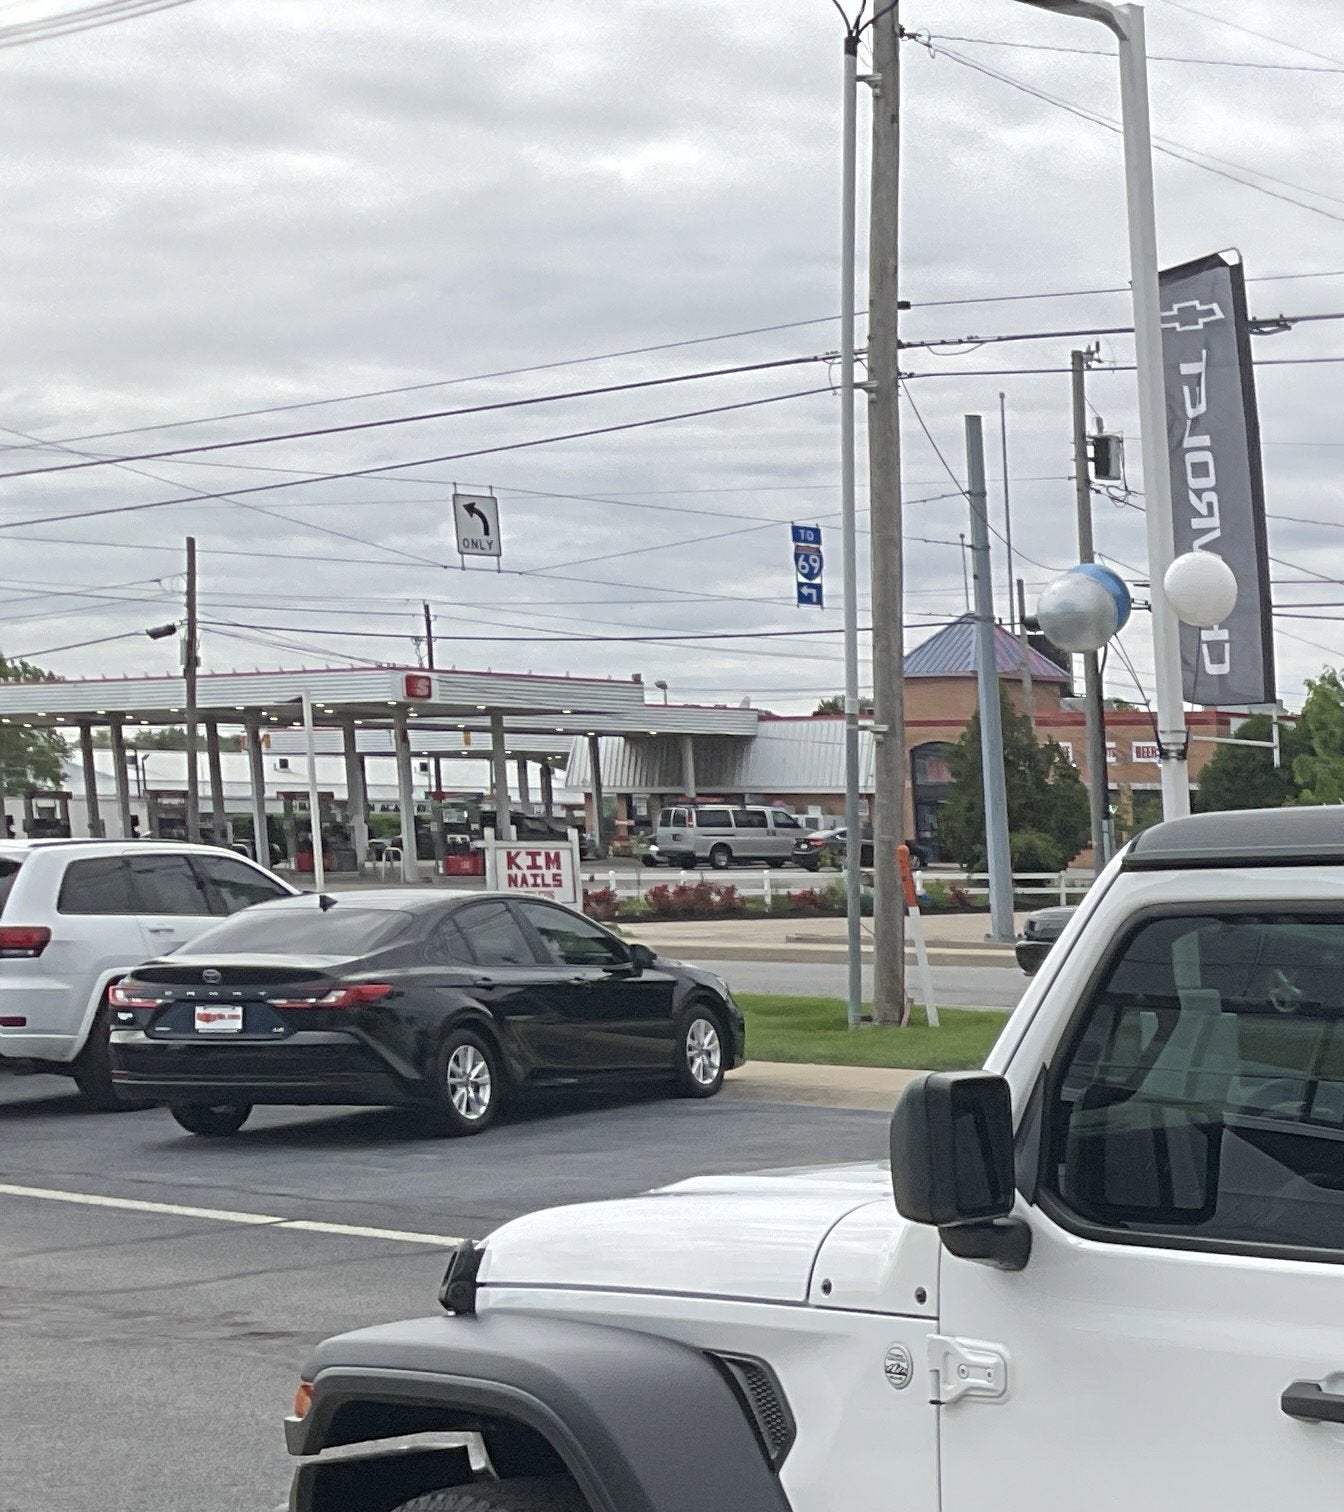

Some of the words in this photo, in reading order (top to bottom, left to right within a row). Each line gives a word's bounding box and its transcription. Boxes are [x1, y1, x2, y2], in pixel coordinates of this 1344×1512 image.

[798, 529, 815, 541] TO
[462, 537, 494, 551] ONLY
[797, 554, 820, 574] 69
[506, 851, 562, 870] KIM
[507, 873, 563, 888] NAILS
